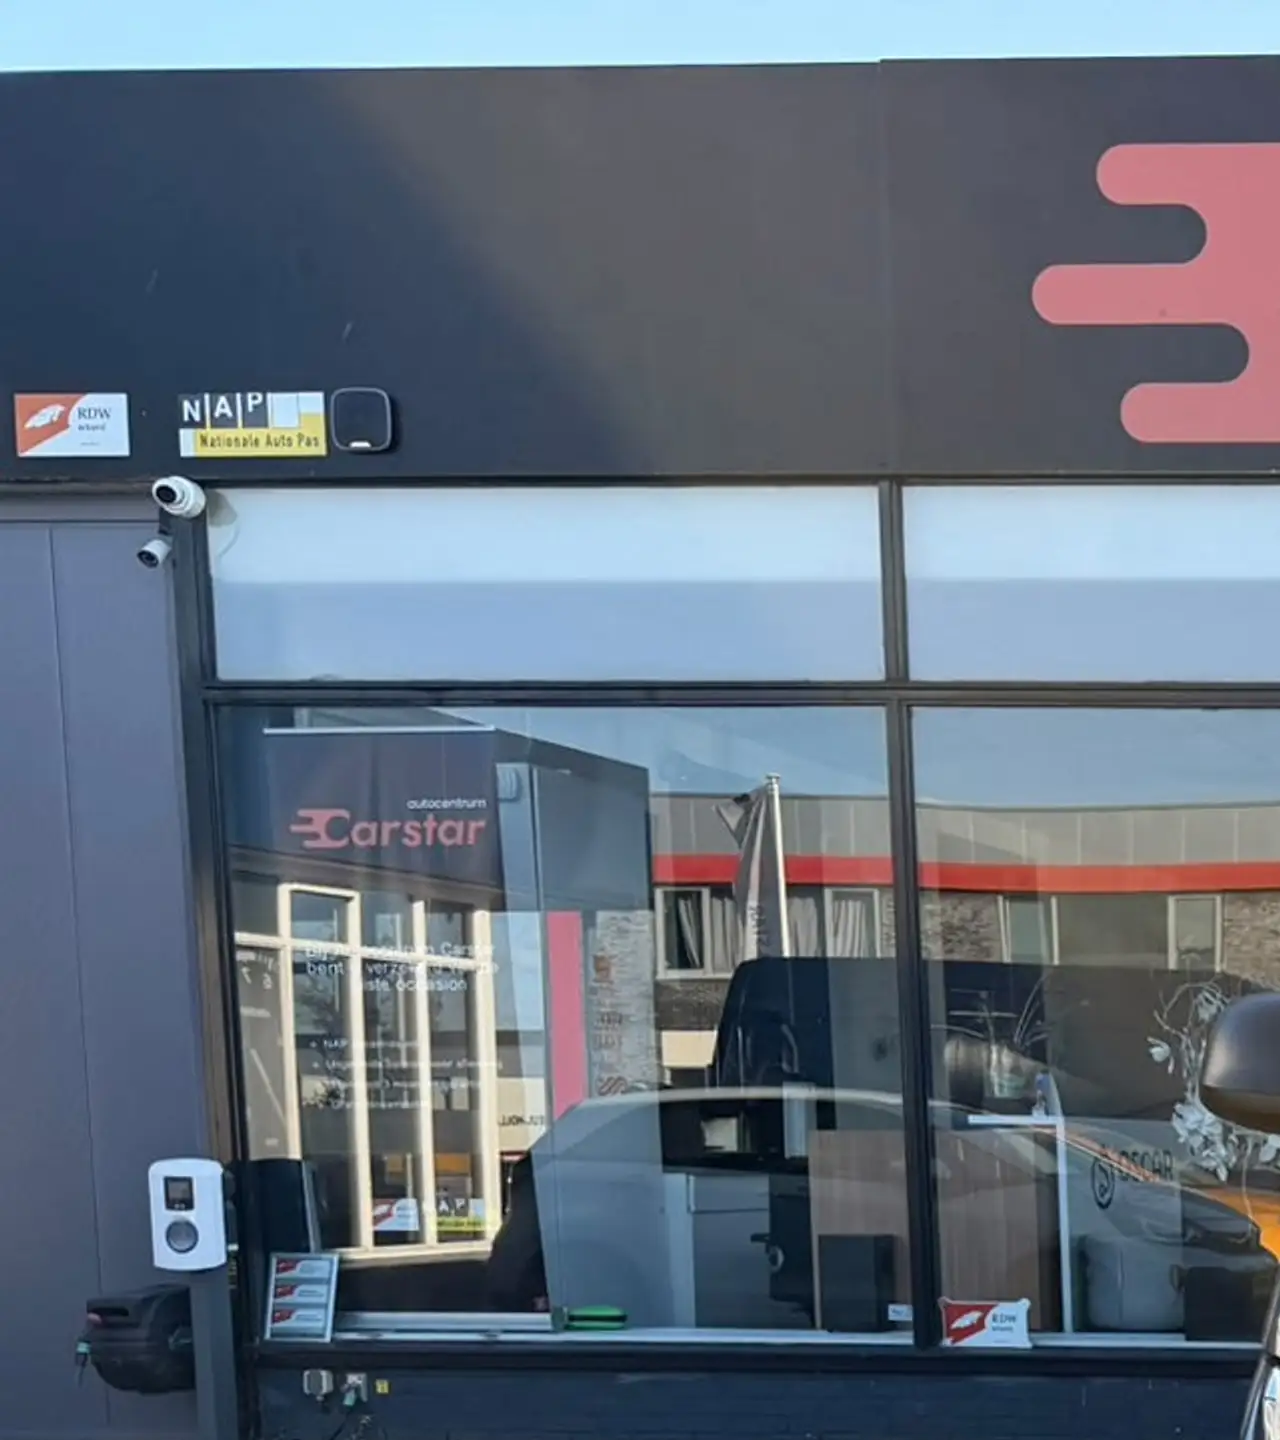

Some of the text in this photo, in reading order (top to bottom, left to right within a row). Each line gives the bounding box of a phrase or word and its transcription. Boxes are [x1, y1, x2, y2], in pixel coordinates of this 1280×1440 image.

[77, 407, 112, 420] RDW
[183, 392, 263, 422] NAP
[200, 431, 320, 448] Nationale Auto Pas
[406, 797, 487, 809] autocentrum
[289, 808, 487, 848] Carstar
